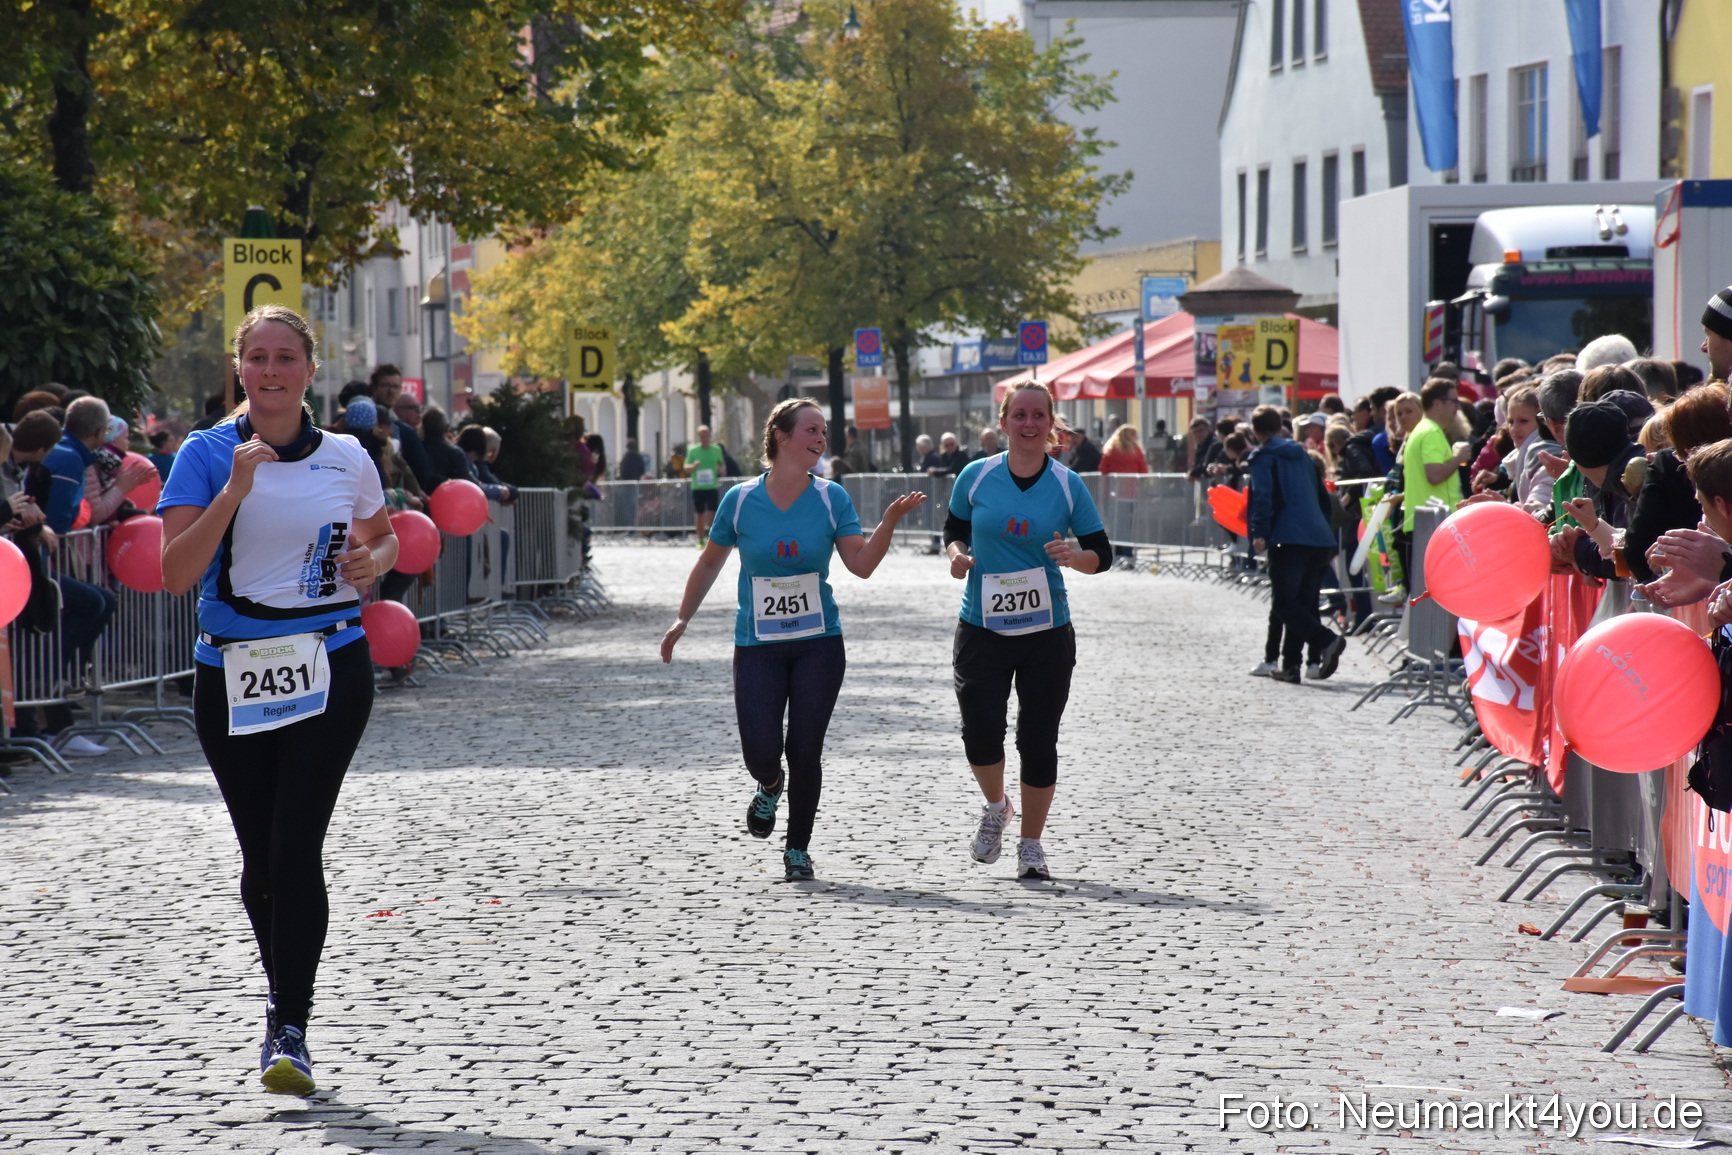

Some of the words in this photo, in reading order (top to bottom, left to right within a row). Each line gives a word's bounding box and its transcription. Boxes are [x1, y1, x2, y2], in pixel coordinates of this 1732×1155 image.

[233, 244, 292, 264] Block
[243, 273, 283, 315] C
[574, 328, 609, 340] Block
[1260, 321, 1295, 333] Block
[581, 345, 603, 378] D
[859, 354, 880, 365] TAXI
[1022, 351, 1045, 362] TAXI
[1266, 339, 1288, 370] D
[303, 543, 314, 564] WASTE
[764, 592, 810, 616] 2451
[991, 589, 1041, 613] 2370
[780, 620, 799, 629] Steffi
[1003, 616, 1033, 626] Kathrina
[259, 645, 296, 657] BOCK
[240, 663, 311, 699] 2431
[1595, 645, 1649, 702] RÖDL
[263, 703, 297, 717] Regina
